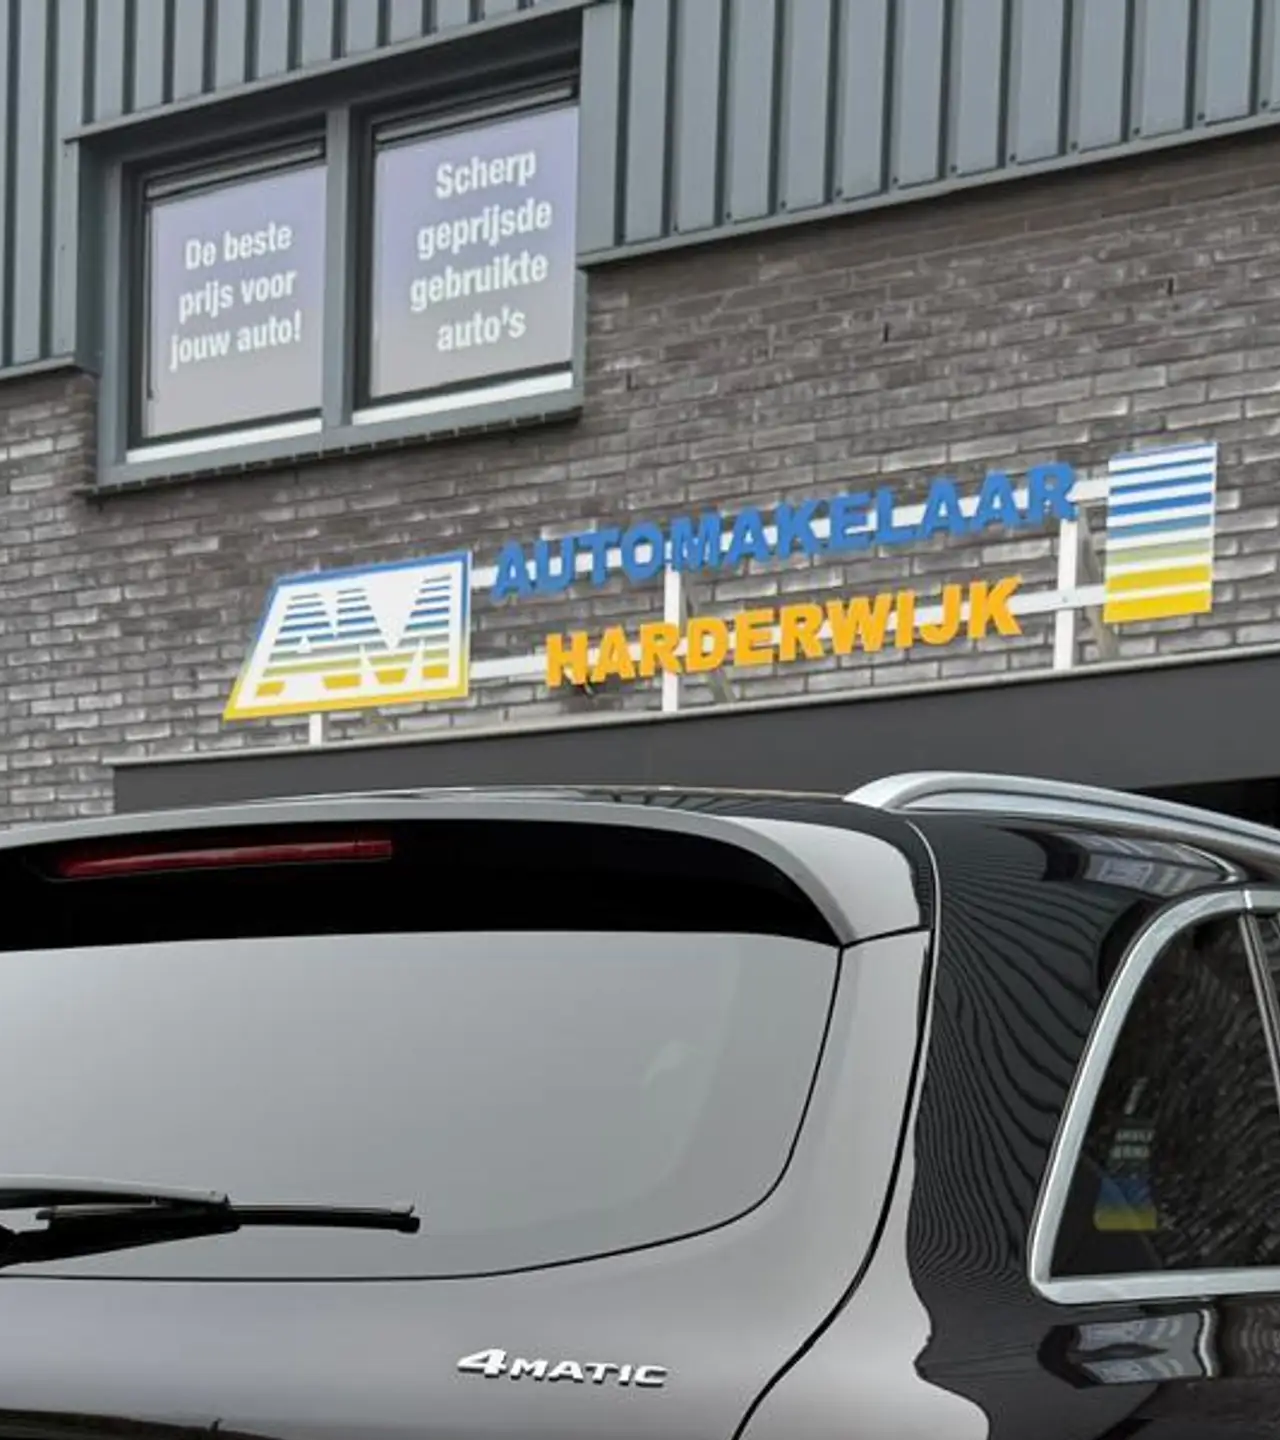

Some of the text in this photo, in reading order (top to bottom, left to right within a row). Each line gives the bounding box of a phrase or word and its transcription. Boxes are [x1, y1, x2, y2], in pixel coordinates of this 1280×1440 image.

[436, 149, 537, 200] Scherp
[184, 222, 293, 271] De beste
[417, 198, 553, 260] geprijsde
[178, 268, 298, 325] prijs voor
[410, 249, 549, 313] gebruikte
[170, 309, 302, 372] jouw auto!
[436, 306, 527, 353] auto's
[490, 460, 1078, 606] AUTOMAKELAAR
[545, 574, 1023, 689] HARDERWIJK
[456, 1348, 669, 1387] 4MATIC
